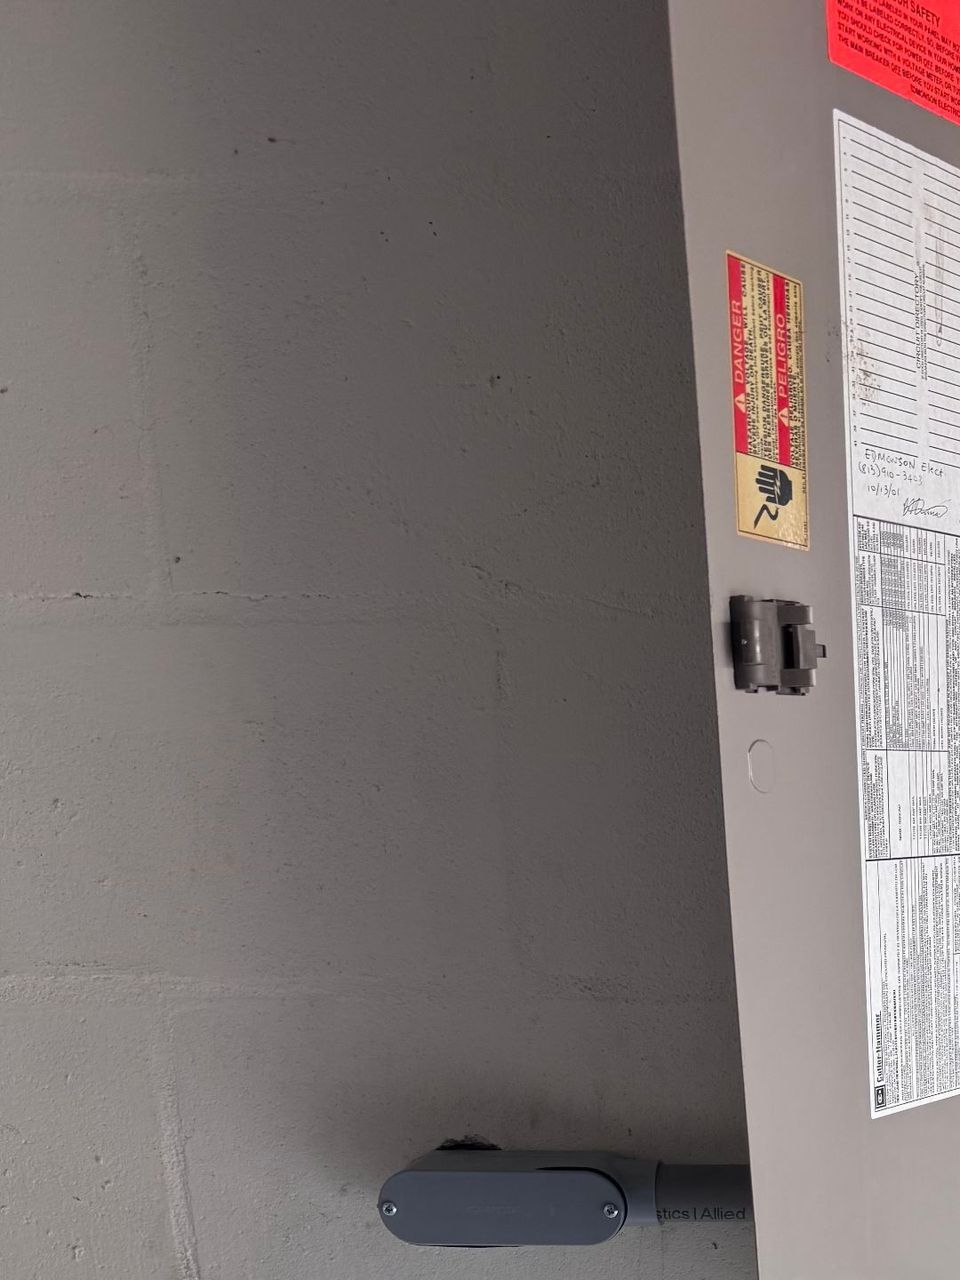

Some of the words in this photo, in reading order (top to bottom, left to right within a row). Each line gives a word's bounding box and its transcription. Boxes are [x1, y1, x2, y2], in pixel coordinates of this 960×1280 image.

[911, 0, 940, 27] SAFETY
[732, 300, 744, 384] DANGER
[776, 313, 787, 398] PELIGRO
[700, 1207, 746, 1220] Allied
